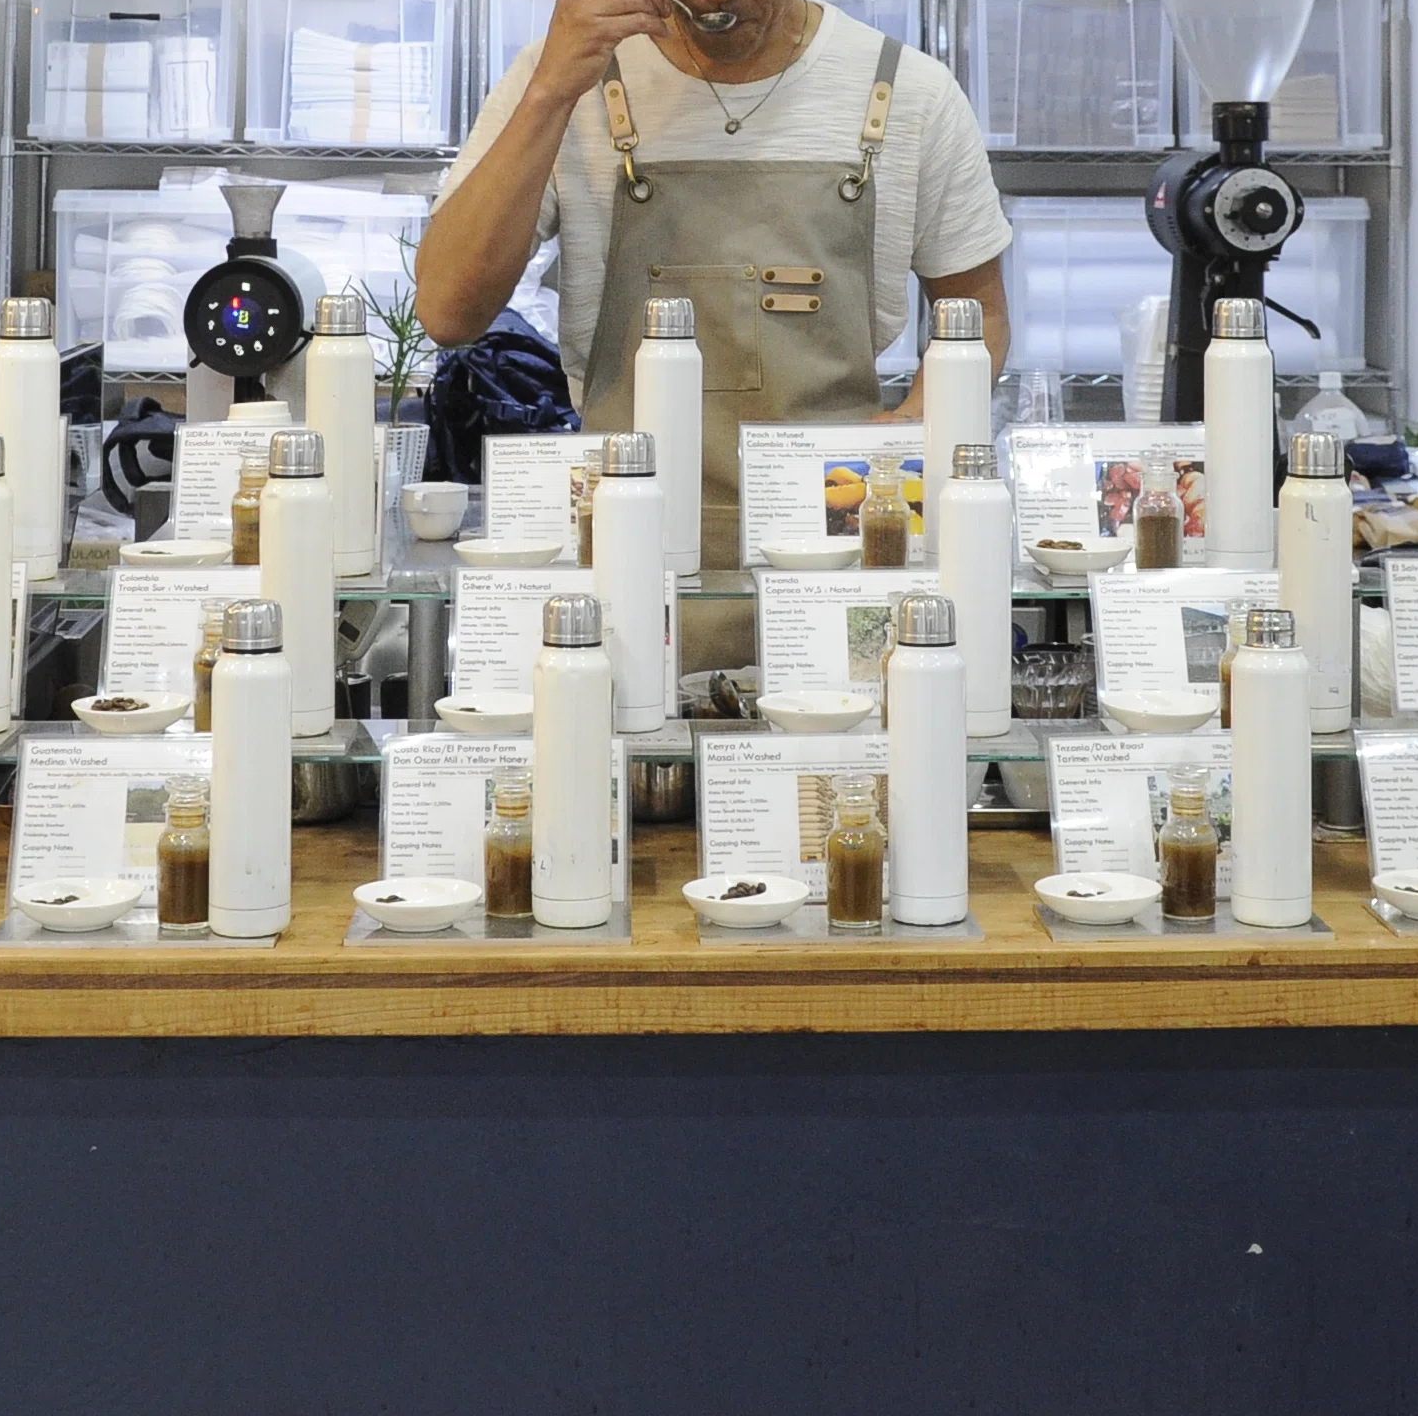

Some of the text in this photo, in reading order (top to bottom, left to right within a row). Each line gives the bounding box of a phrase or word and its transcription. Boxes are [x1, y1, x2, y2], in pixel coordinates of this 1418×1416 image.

[746, 431, 804, 439] Peach Infused
[1392, 564, 1399, 572] El
[1393, 574, 1415, 582] Santa
[174, 584, 209, 592] Washed
[519, 583, 551, 591] Natural
[31, 746, 83, 755] Guatemala
[493, 744, 517, 752] Farm
[707, 742, 752, 751] Kenya AA
[1120, 742, 1144, 751] Roast
[393, 756, 411, 765] Don
[414, 756, 441, 765] Oscar
[466, 755, 496, 764] Yellow
[500, 755, 529, 765] Honey
[744, 752, 781, 761] Washed
[1094, 753, 1130, 762] Washed
[70, 757, 108, 766] Washed
[708, 778, 735, 786] General
[391, 842, 419, 850] Cupping
[709, 839, 738, 848] Cupping
